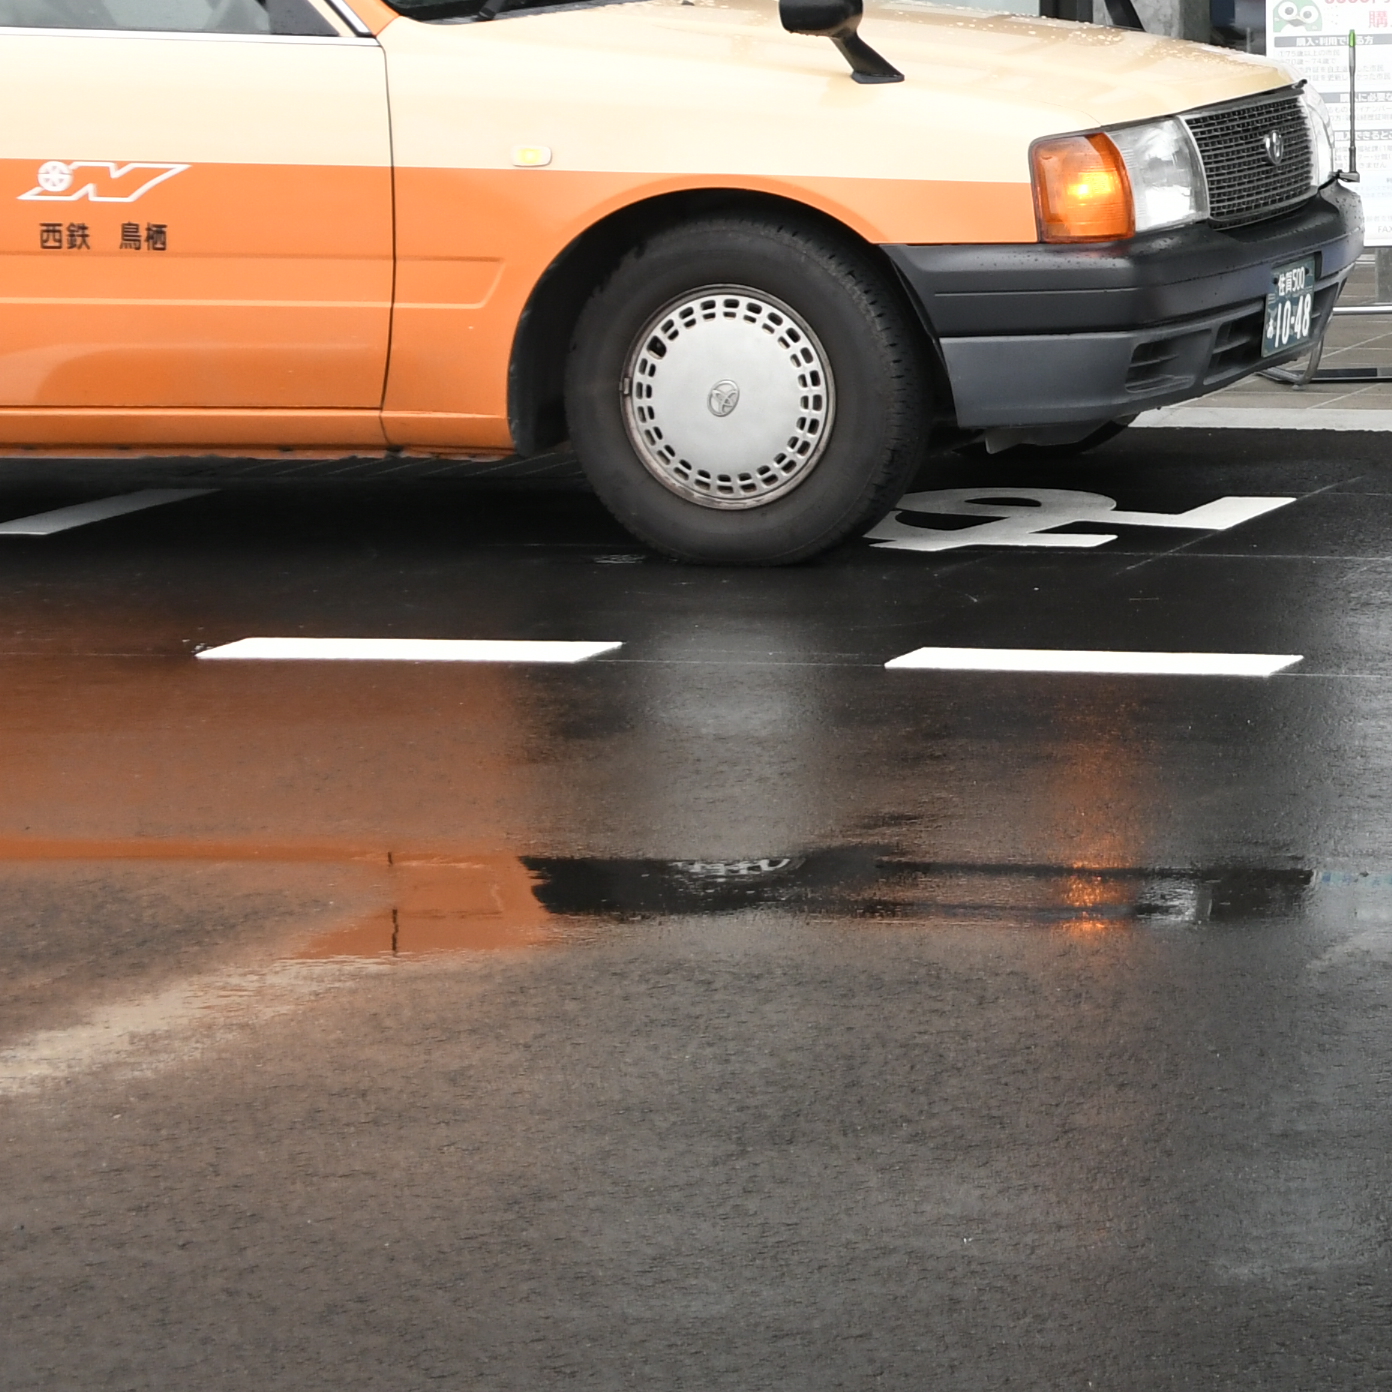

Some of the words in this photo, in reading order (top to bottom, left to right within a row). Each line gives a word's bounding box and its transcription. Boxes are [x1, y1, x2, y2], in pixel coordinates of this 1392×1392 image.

[1296, 36, 1374, 46] 購入・利用でる方
[39, 221, 91, 251] 西鉄
[119, 221, 168, 252] 鳥栖
